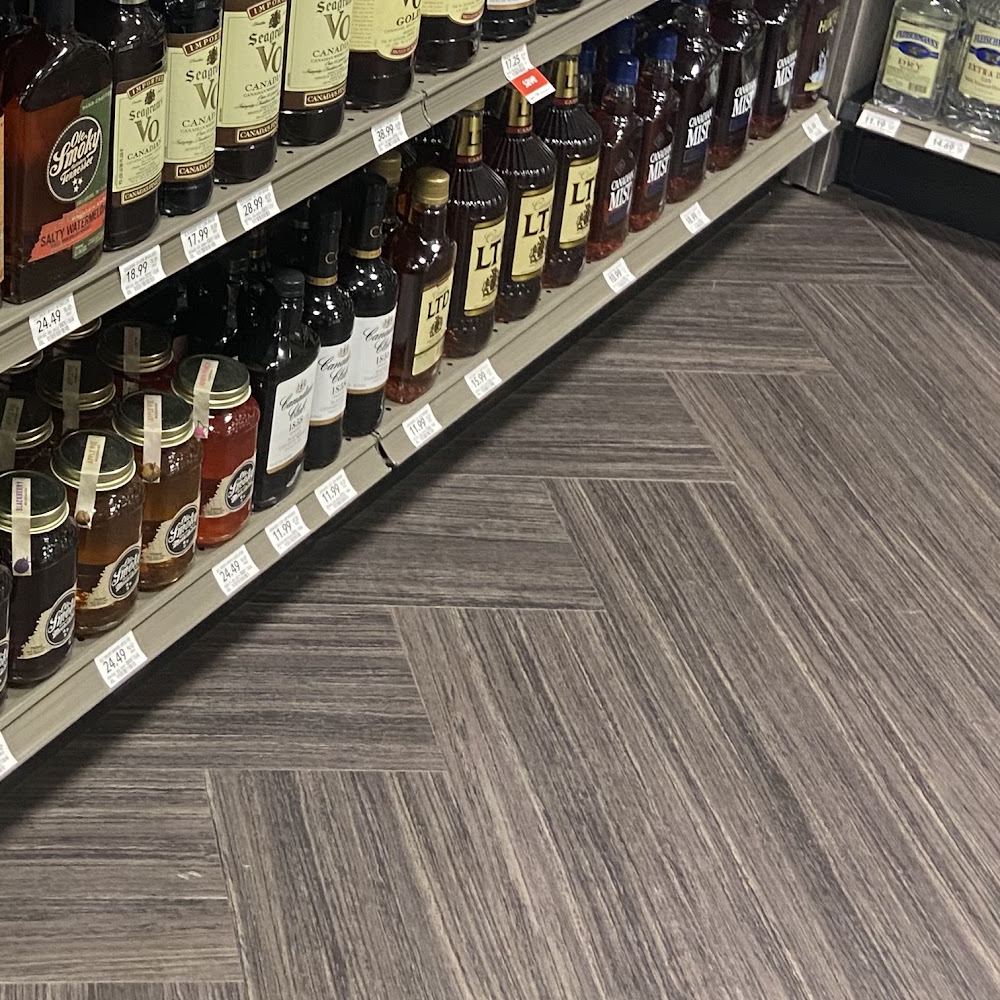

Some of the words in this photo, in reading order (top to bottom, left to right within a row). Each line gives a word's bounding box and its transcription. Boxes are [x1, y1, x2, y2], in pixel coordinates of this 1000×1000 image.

[324, 12, 350, 43] VO
[256, 41, 282, 74] VO
[521, 75, 539, 89] save
[134, 115, 160, 144] VO
[376, 124, 394, 139] 38.99
[685, 123, 711, 148] MIST
[49, 128, 101, 177] Smoky
[60, 154, 95, 186] Tennessee
[647, 158, 671, 183] MIST
[242, 196, 264, 216] 28.99
[608, 187, 633, 212] MIST
[40, 227, 65, 248] SALTY
[187, 226, 210, 246] 17.99
[126, 261, 149, 284] 18.99
[427, 289, 449, 319] LTD
[36, 308, 62, 334] 24.49
[470, 372, 488, 388] 15.99
[409, 416, 429, 435] 11.99
[321, 484, 342, 504] 11.99
[272, 520, 293, 540] 11.99
[219, 560, 241, 582] 24.49
[102, 647, 128, 674] 24.49
